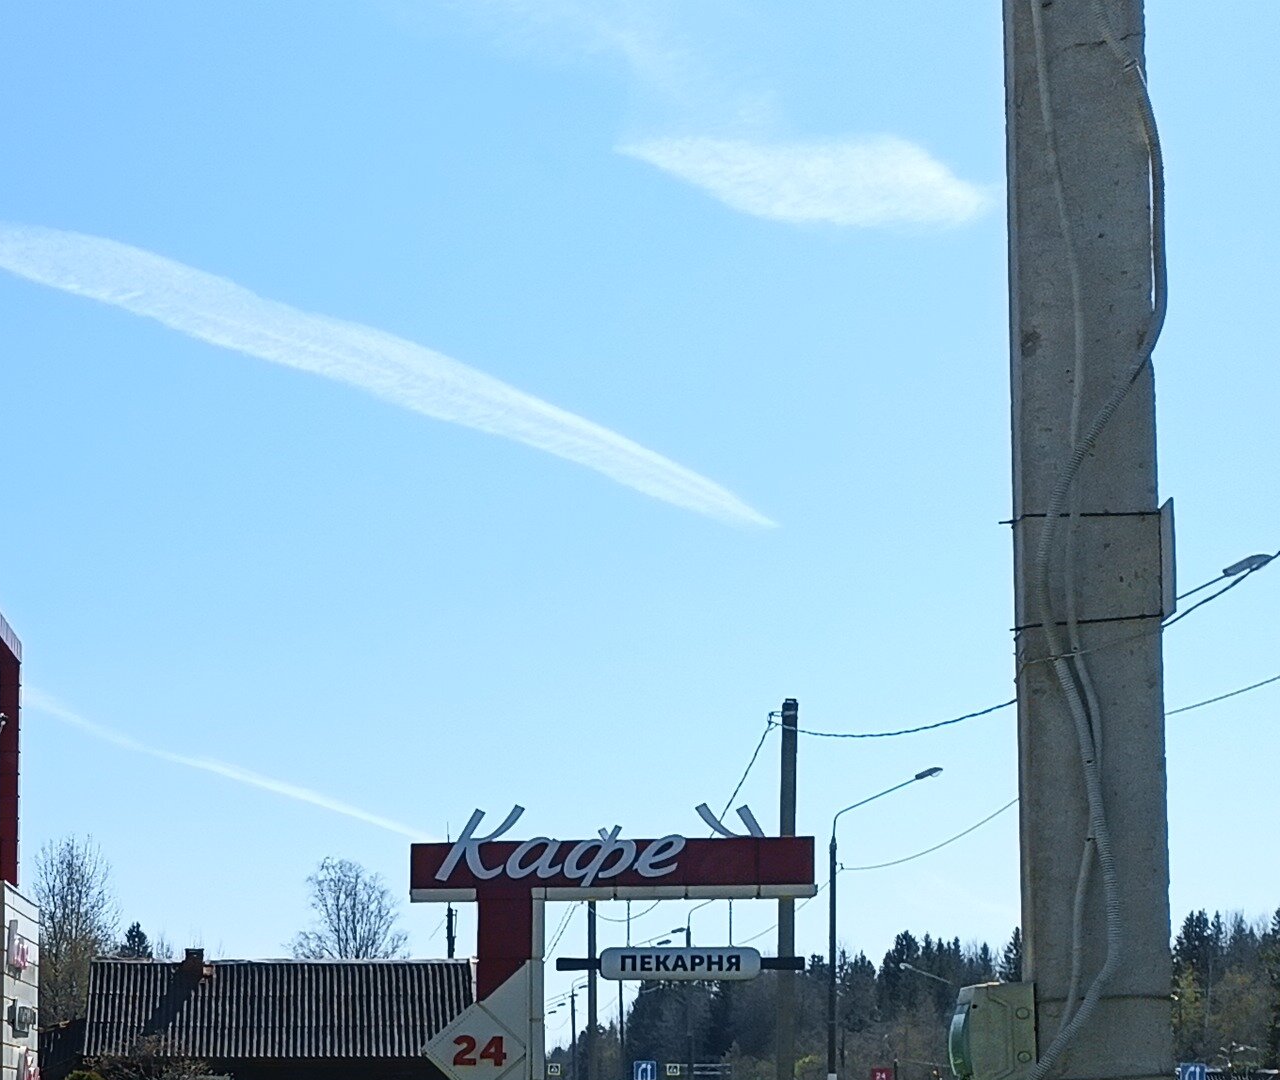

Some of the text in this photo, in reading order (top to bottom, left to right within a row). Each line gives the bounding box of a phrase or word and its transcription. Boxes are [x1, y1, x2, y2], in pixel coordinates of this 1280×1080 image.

[435, 804, 686, 887] Кафе
[620, 954, 741, 972] ПЕКАРНЯ
[453, 1035, 507, 1067] 24
